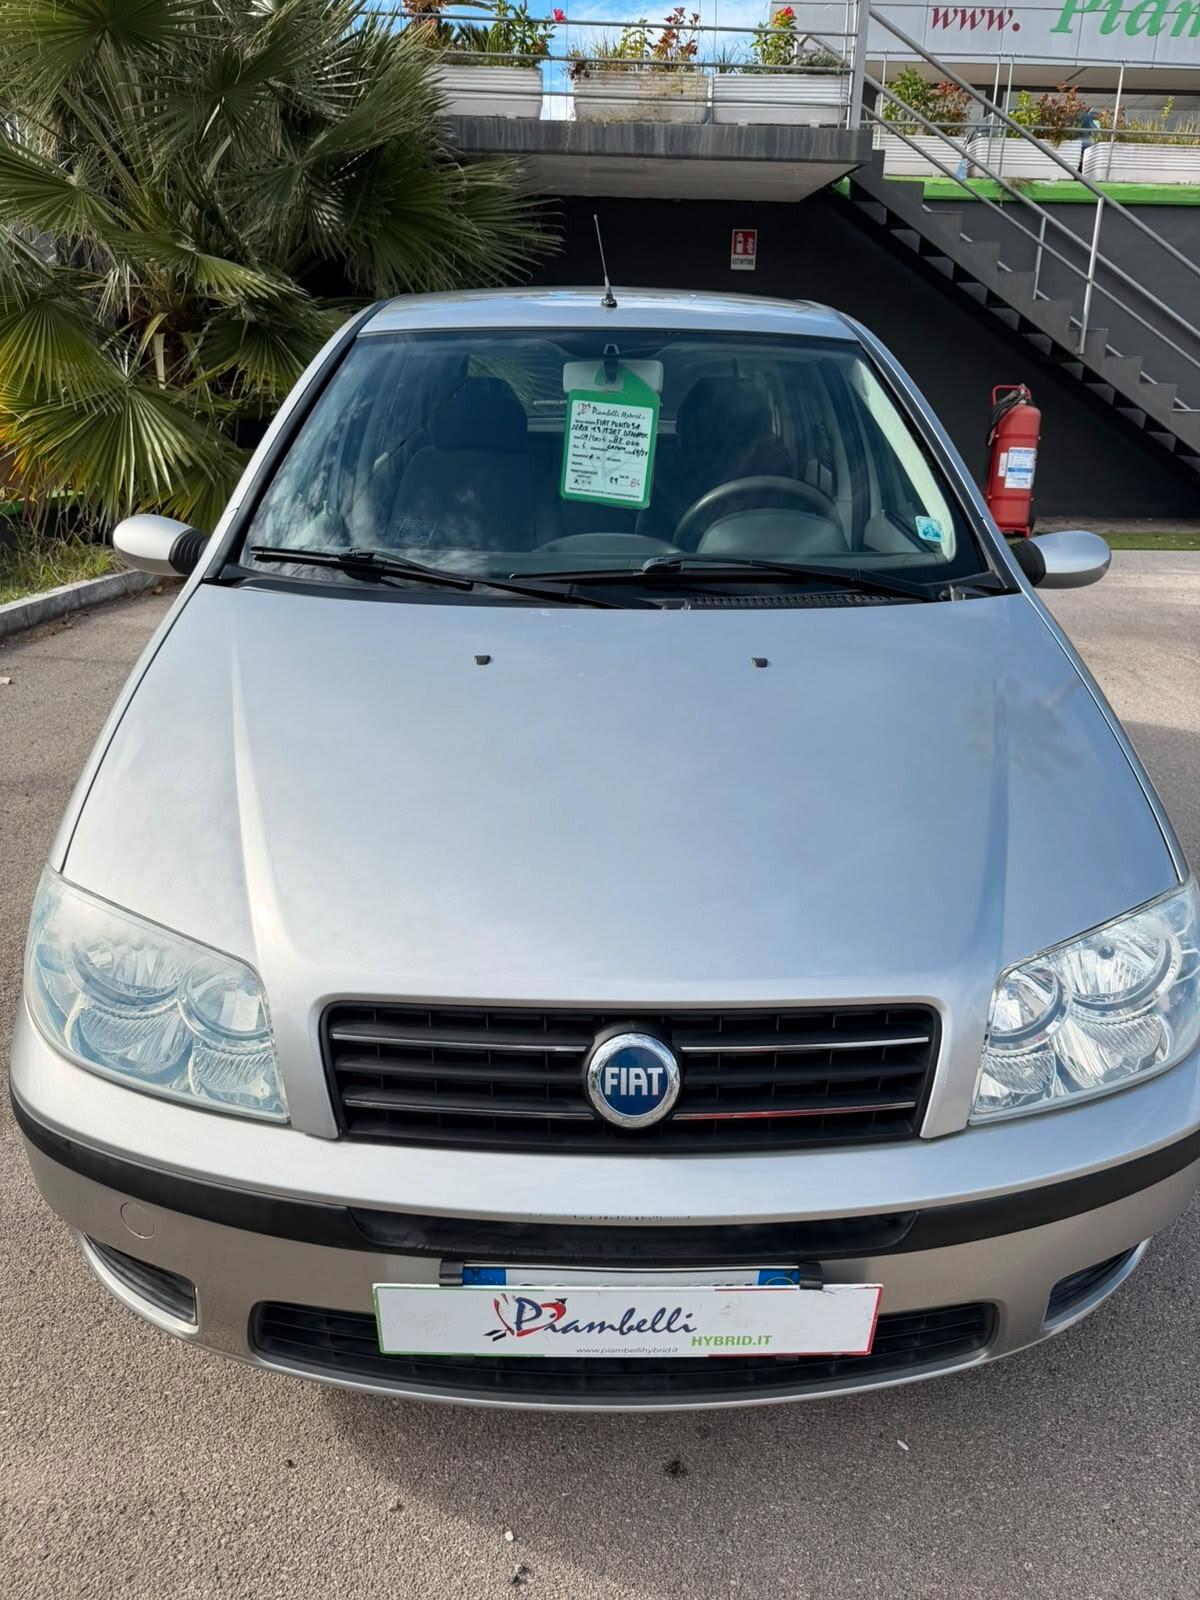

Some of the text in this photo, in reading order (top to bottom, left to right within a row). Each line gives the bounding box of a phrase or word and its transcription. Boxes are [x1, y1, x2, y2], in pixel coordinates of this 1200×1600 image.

[931, 7, 1021, 32] www.
[604, 1067, 664, 1096] FIAT
[514, 1296, 698, 1336] Piambelli
[691, 1335, 773, 1347] HYBRID.IT
